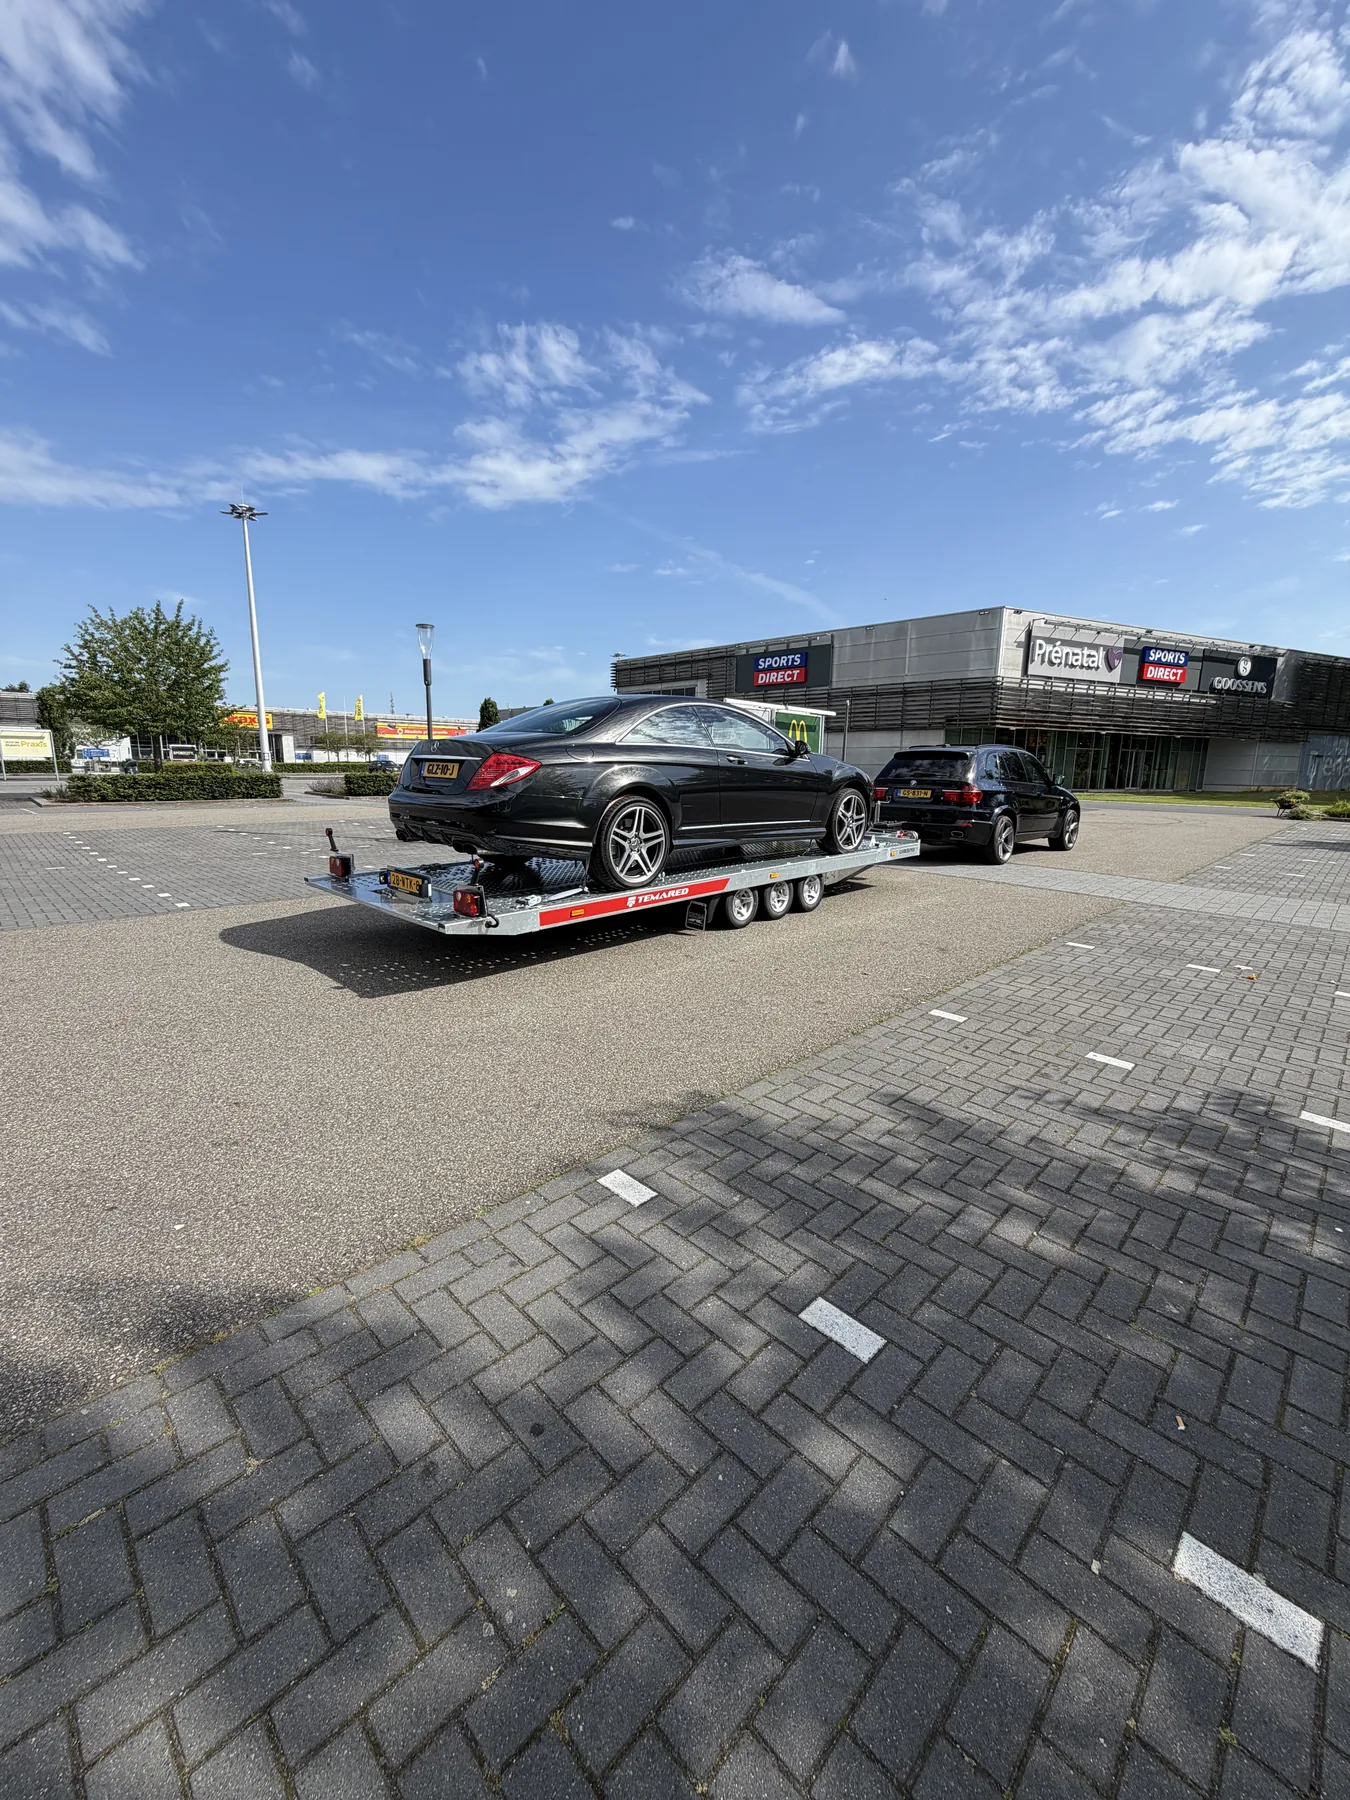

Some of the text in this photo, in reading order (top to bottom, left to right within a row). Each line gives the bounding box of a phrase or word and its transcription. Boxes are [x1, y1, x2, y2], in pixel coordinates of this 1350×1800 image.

[1034, 639, 1104, 668] Prénatal
[1149, 649, 1186, 664] SPORTS
[758, 654, 801, 669] SPORTS
[757, 670, 800, 684] DIRECT
[1147, 666, 1183, 681] DIRECT
[1213, 677, 1267, 694] GOOSSENS
[426, 763, 455, 776] GLZ-10-J
[637, 887, 689, 904] TEMARED
